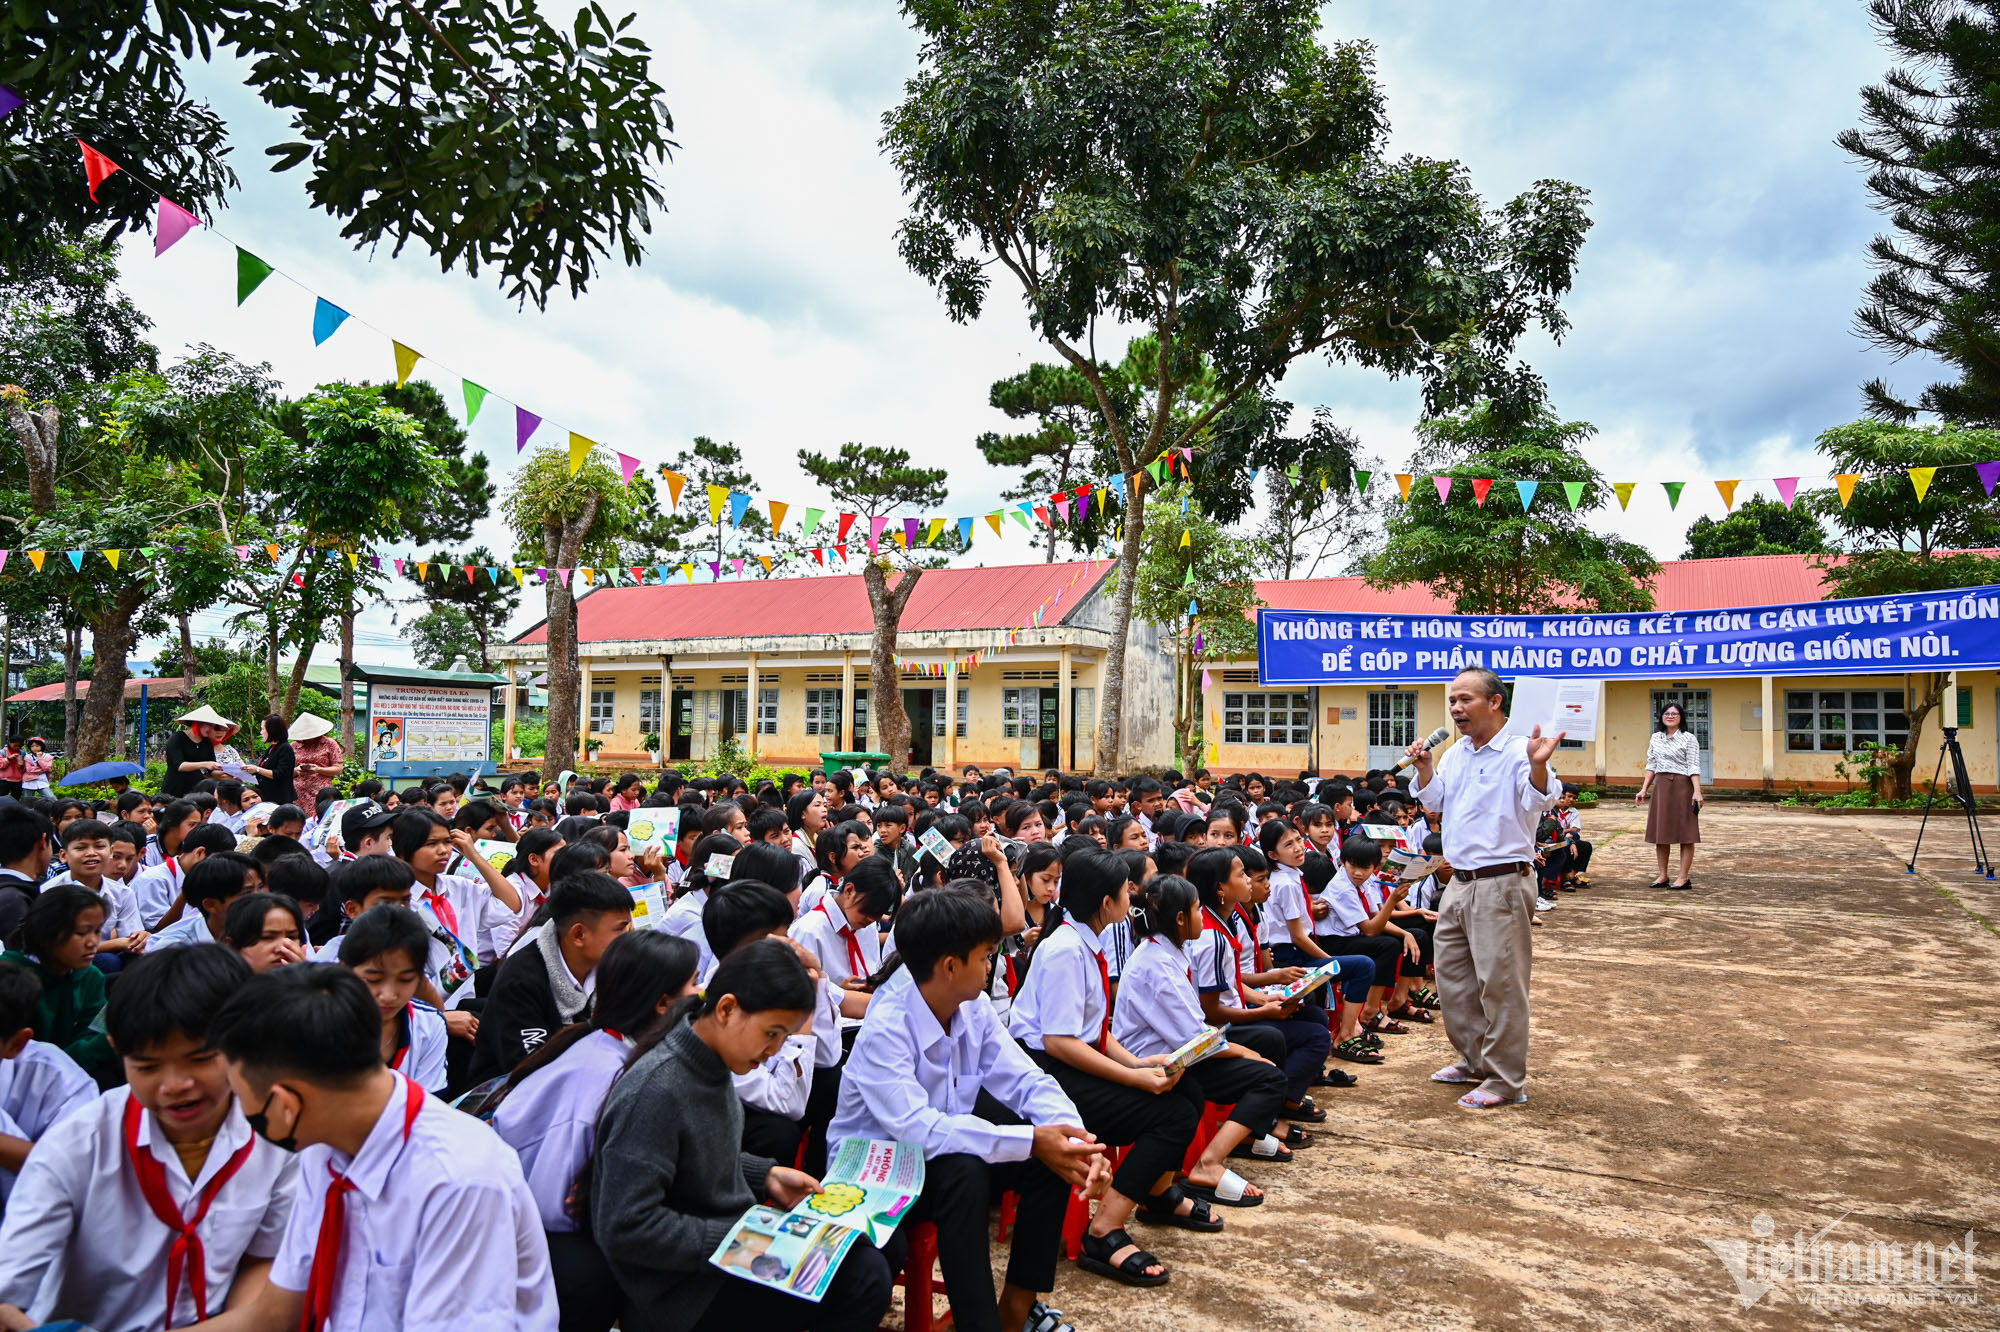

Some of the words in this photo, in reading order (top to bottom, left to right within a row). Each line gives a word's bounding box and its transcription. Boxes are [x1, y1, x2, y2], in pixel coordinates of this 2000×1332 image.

[1273, 618, 1352, 641] KHÔNG
[1361, 617, 1404, 639] KẾT
[1411, 618, 1462, 639] HÔN
[1470, 619, 1535, 640] SỚM,
[1543, 617, 1630, 638] KHÔNG
[1639, 611, 1687, 635] KẾT
[1695, 611, 1751, 633] HÔN
[1759, 608, 1818, 632] CẬN
[1826, 598, 1913, 626] HUYẾT
[1922, 592, 1999, 621] THỐN
[1321, 644, 1353, 672] ĐỂ
[1360, 648, 1408, 672] GÓP
[1415, 644, 1483, 670] PHẦN
[1492, 645, 1562, 670] NÂNG
[1571, 647, 1622, 668] CAO
[1630, 639, 1698, 666] CHẤT
[1706, 640, 1795, 667] LƯỢNG
[1803, 632, 1891, 661] GIỐNG
[1900, 631, 1959, 658] NÒI.
[395, 687, 427, 695] TRƯỜNG
[875, 1148, 893, 1182] KHÔNG
